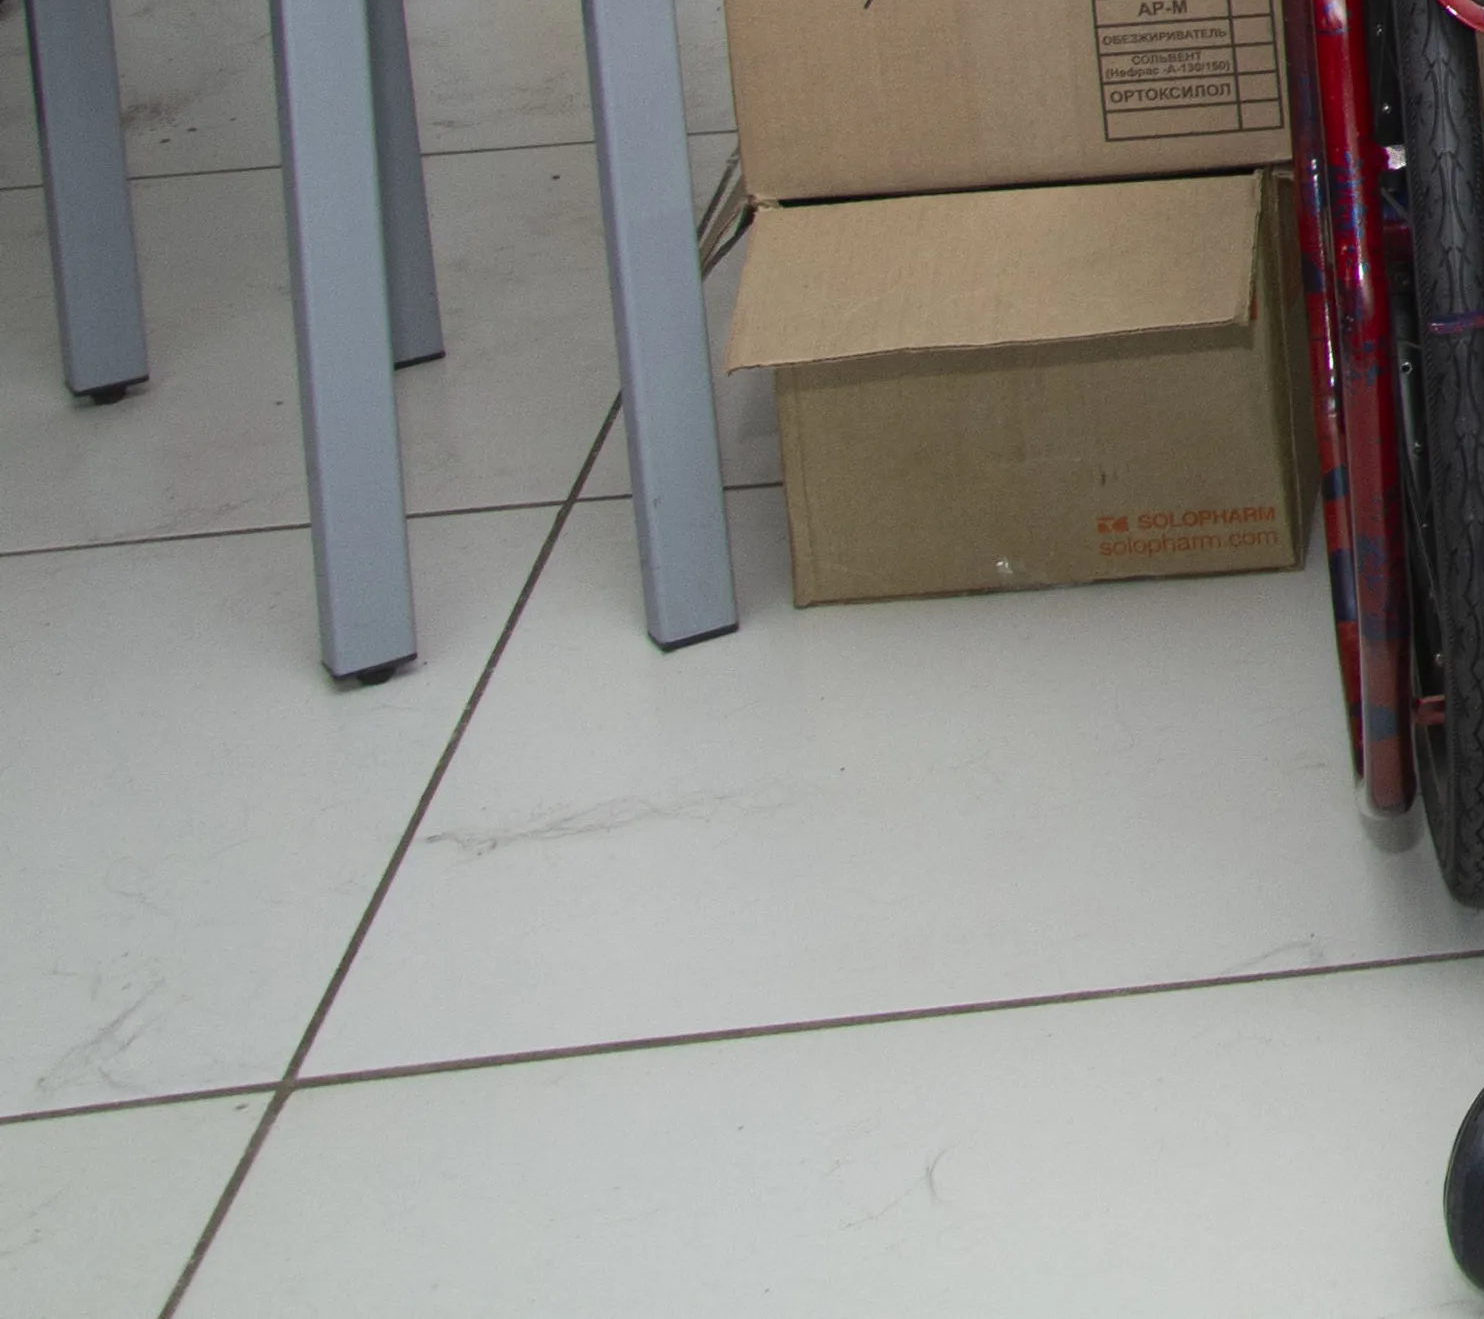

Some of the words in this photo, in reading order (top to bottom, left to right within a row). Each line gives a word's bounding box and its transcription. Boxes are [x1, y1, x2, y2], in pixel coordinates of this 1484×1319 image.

[1102, 26, 1227, 47] ОБЕЗЖИРИВАТЕЛЬ
[1131, 50, 1202, 66] СОЛЬВЕНТ
[1110, 82, 1232, 103] ОРТОКСИЛОЛ
[1138, 506, 1277, 530] SOLOPHARM
